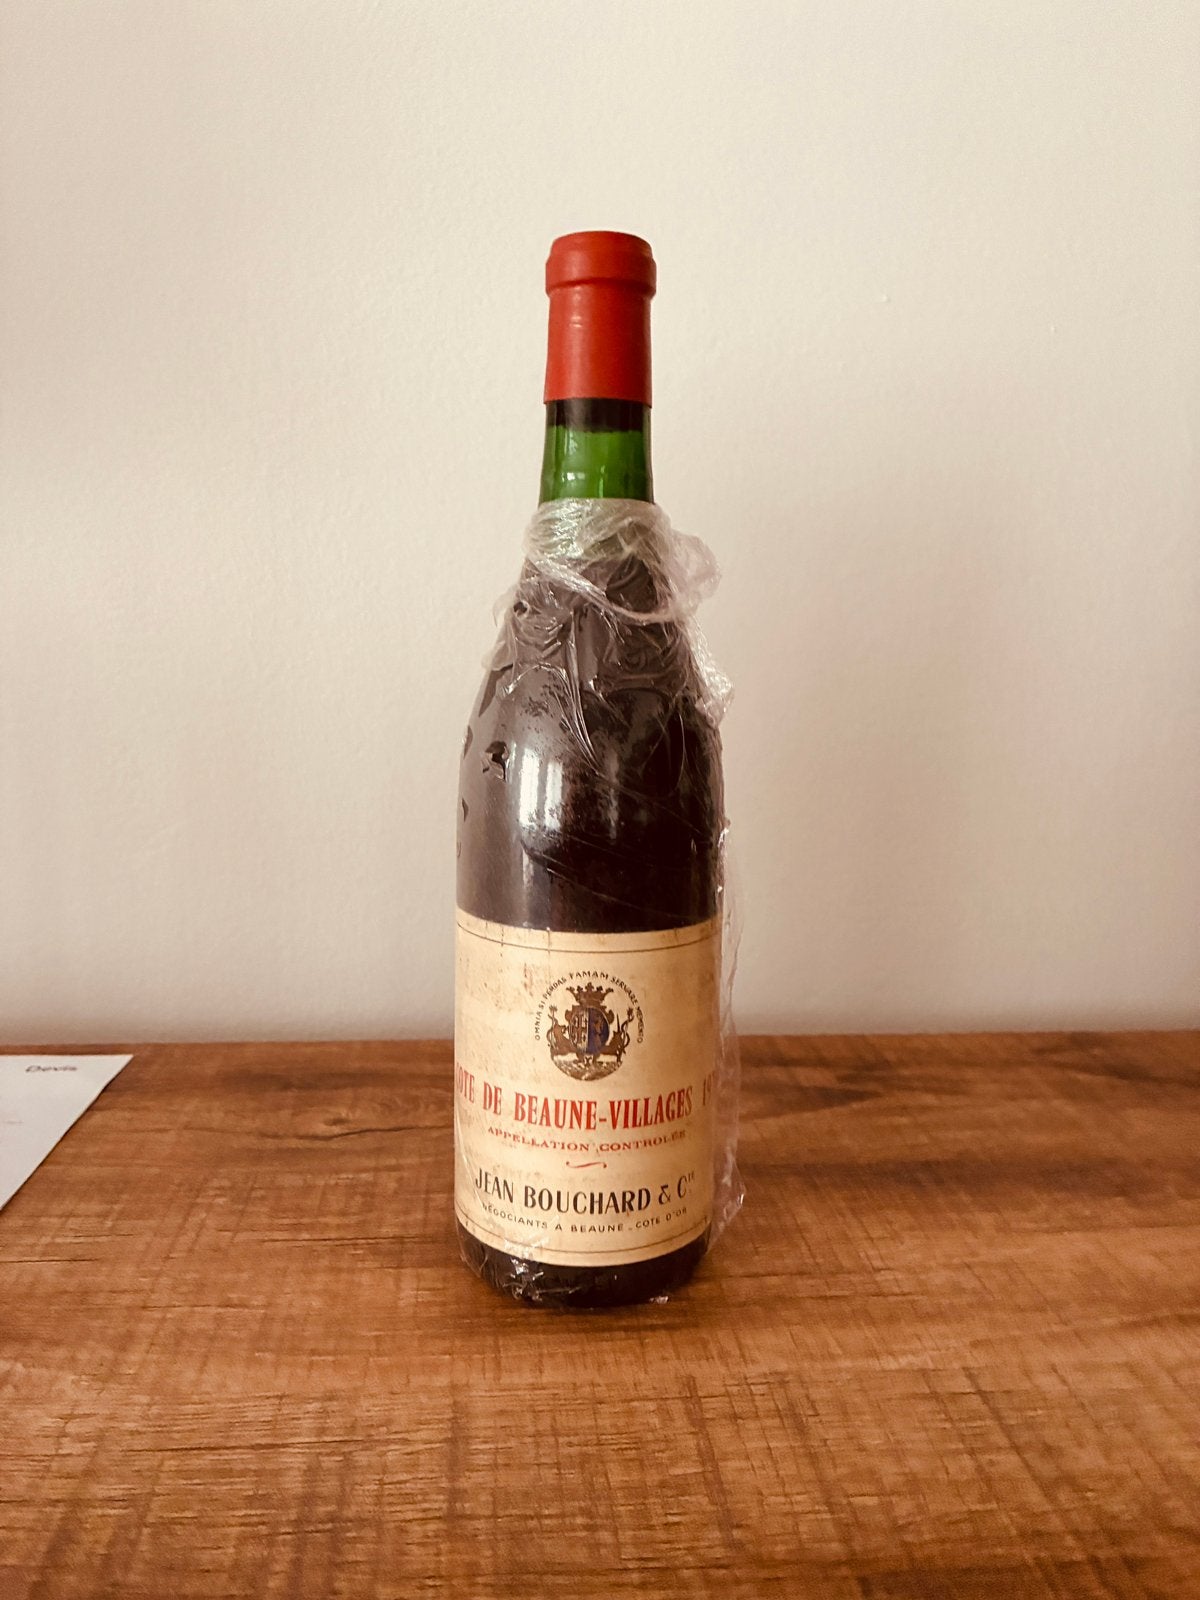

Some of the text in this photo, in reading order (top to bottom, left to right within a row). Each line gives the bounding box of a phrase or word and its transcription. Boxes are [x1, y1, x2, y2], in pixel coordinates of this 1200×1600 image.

[538, 1000, 546, 1010] SI
[534, 1010, 543, 1041] OMNIA
[483, 1080, 502, 1116] DE
[514, 1085, 693, 1131] BEAUNE-VILLAGES
[488, 1126, 590, 1152] APPELLATION
[475, 1167, 514, 1204] JEAN
[524, 1184, 651, 1216] BOUCHARD
[658, 1183, 672, 1206] &
[570, 1222, 624, 1233] BEAUNE
